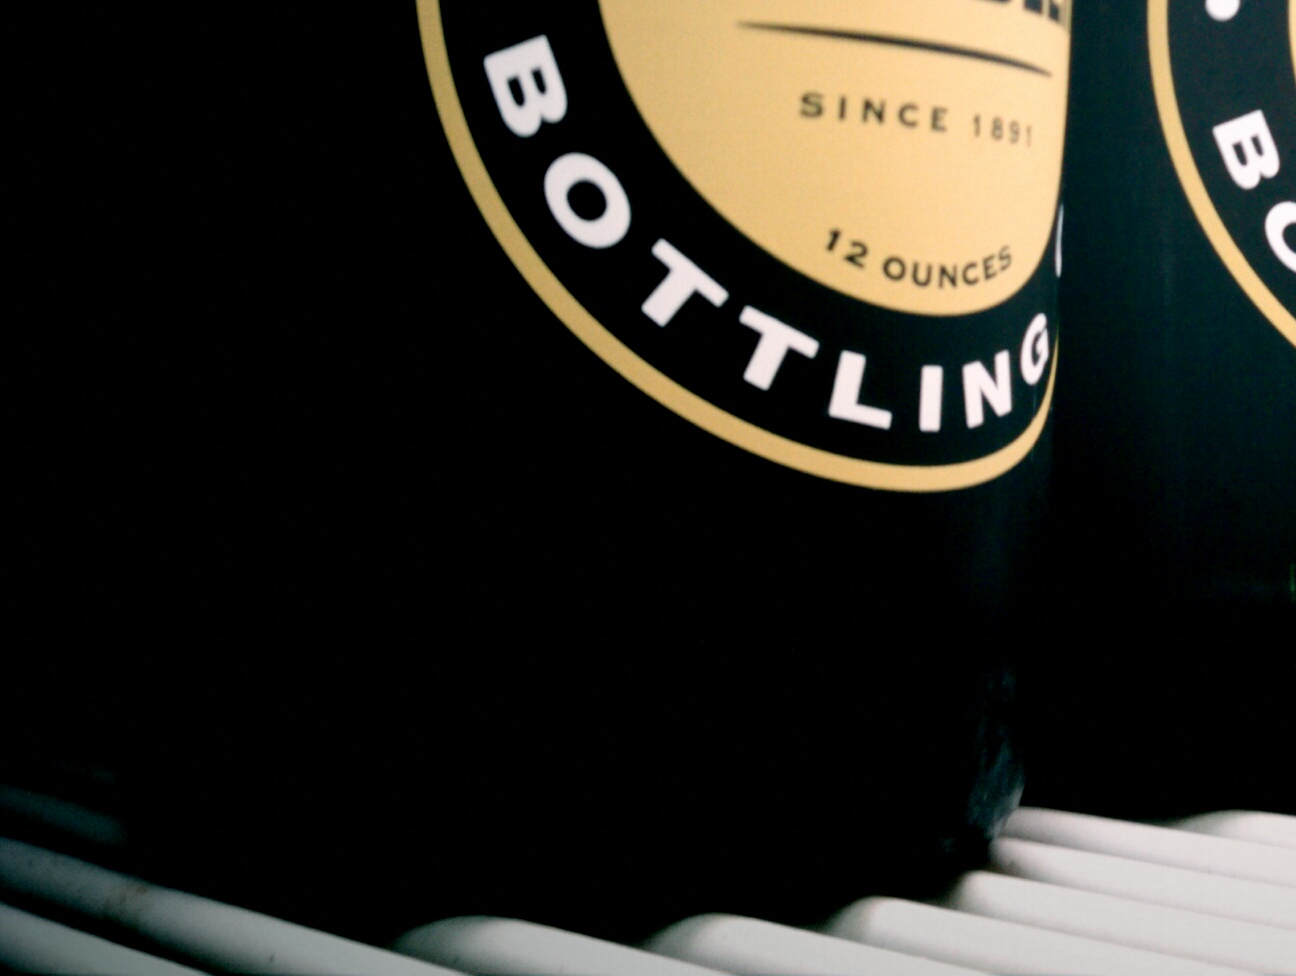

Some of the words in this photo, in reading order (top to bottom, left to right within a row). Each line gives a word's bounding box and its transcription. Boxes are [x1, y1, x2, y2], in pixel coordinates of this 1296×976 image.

[800, 92, 948, 133] SINCE
[973, 114, 1035, 149] 1891
[482, 33, 1051, 434] BOTTLING
[826, 228, 867, 268] 12
[883, 246, 1013, 290] OUNCES
